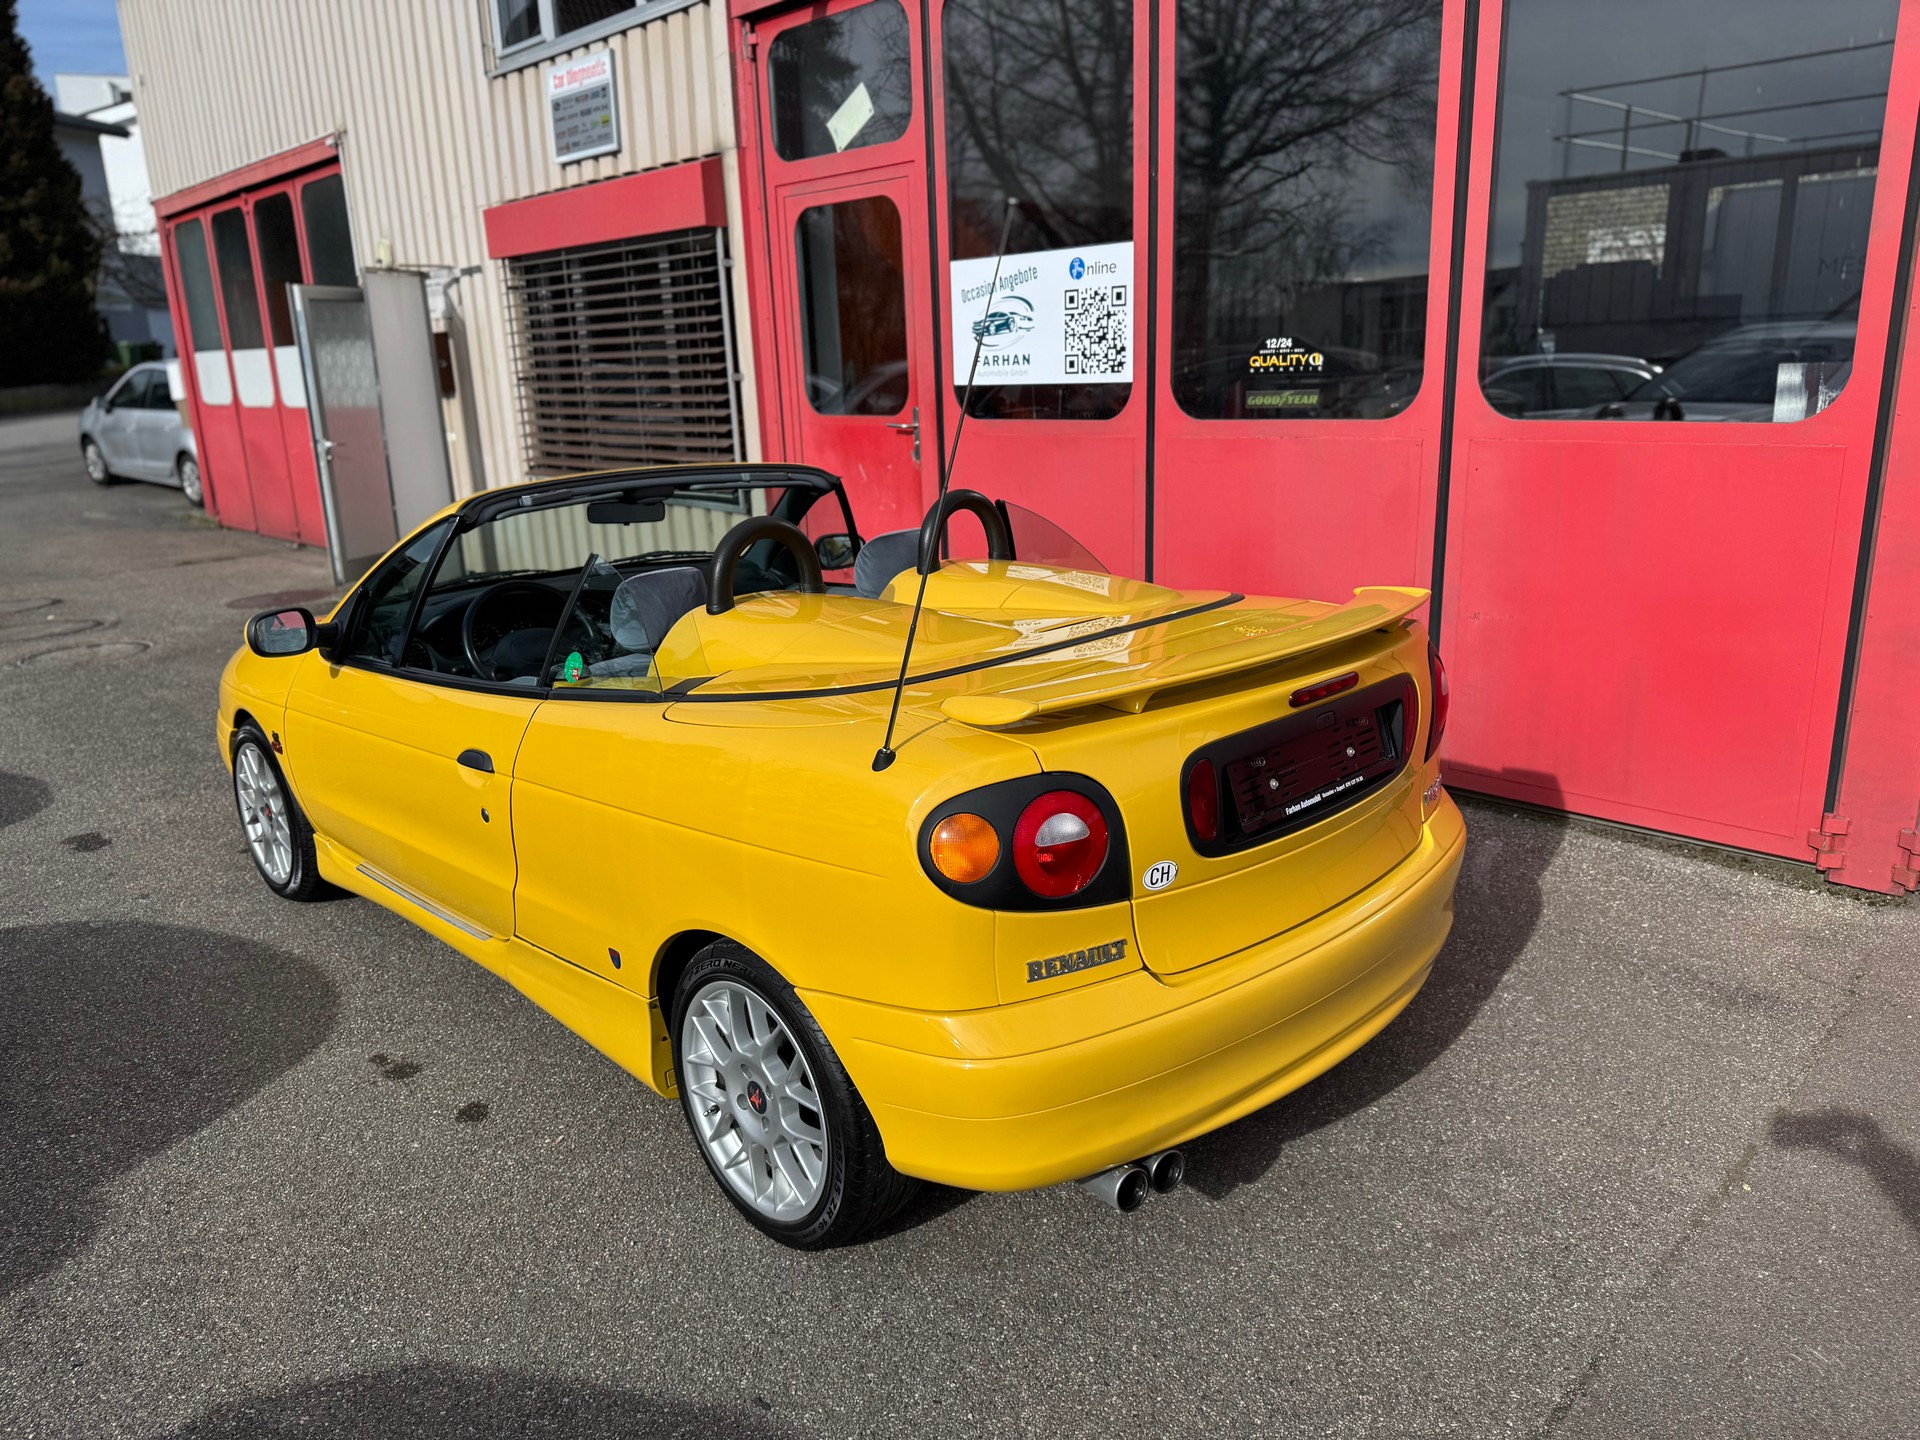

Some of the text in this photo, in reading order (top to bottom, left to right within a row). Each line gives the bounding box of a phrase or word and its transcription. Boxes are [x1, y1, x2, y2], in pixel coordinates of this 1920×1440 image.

[553, 73, 564, 89] Car
[999, 266, 1038, 292] Angebote
[1265, 337, 1293, 349] 12/24
[1150, 864, 1171, 886] CH
[1026, 938, 1129, 983] RENAULT
